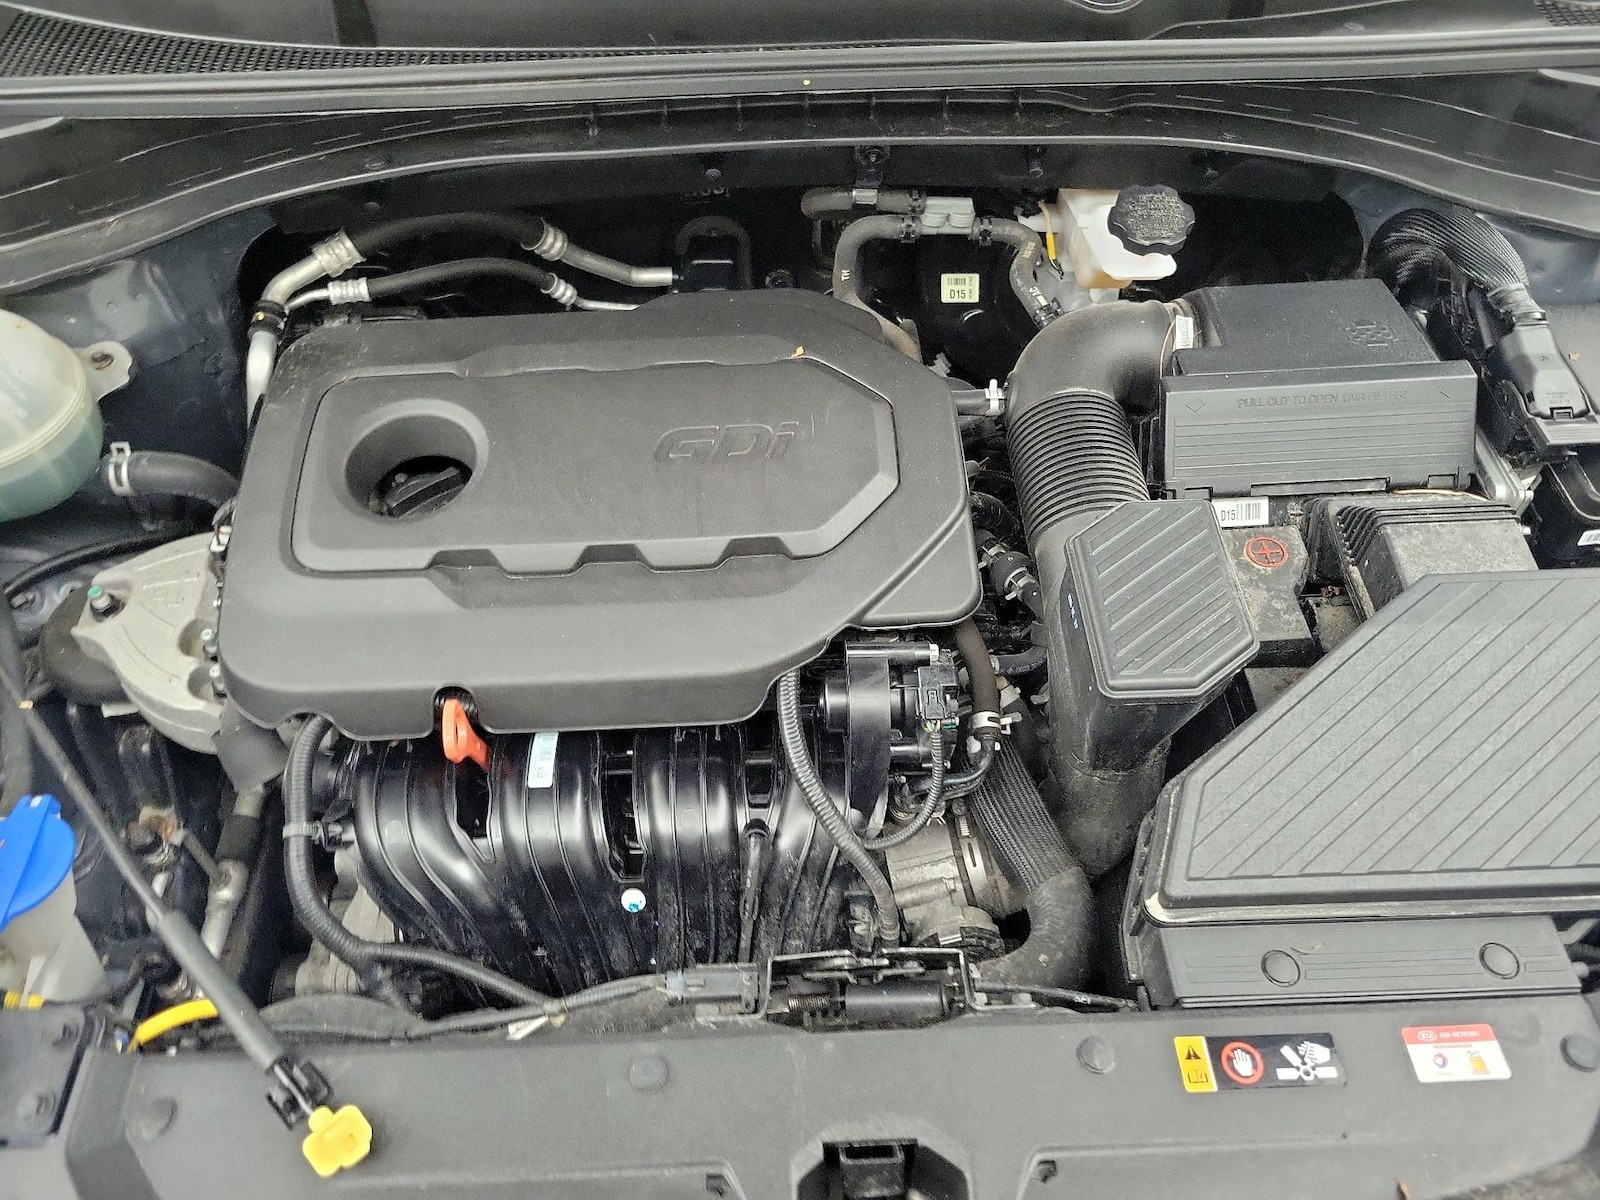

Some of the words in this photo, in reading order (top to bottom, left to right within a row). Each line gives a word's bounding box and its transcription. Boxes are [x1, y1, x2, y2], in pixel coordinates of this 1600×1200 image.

[949, 289, 966, 299] D15
[1293, 394, 1306, 405] TO
[653, 421, 799, 460] GDi
[1220, 509, 1236, 521] D15
